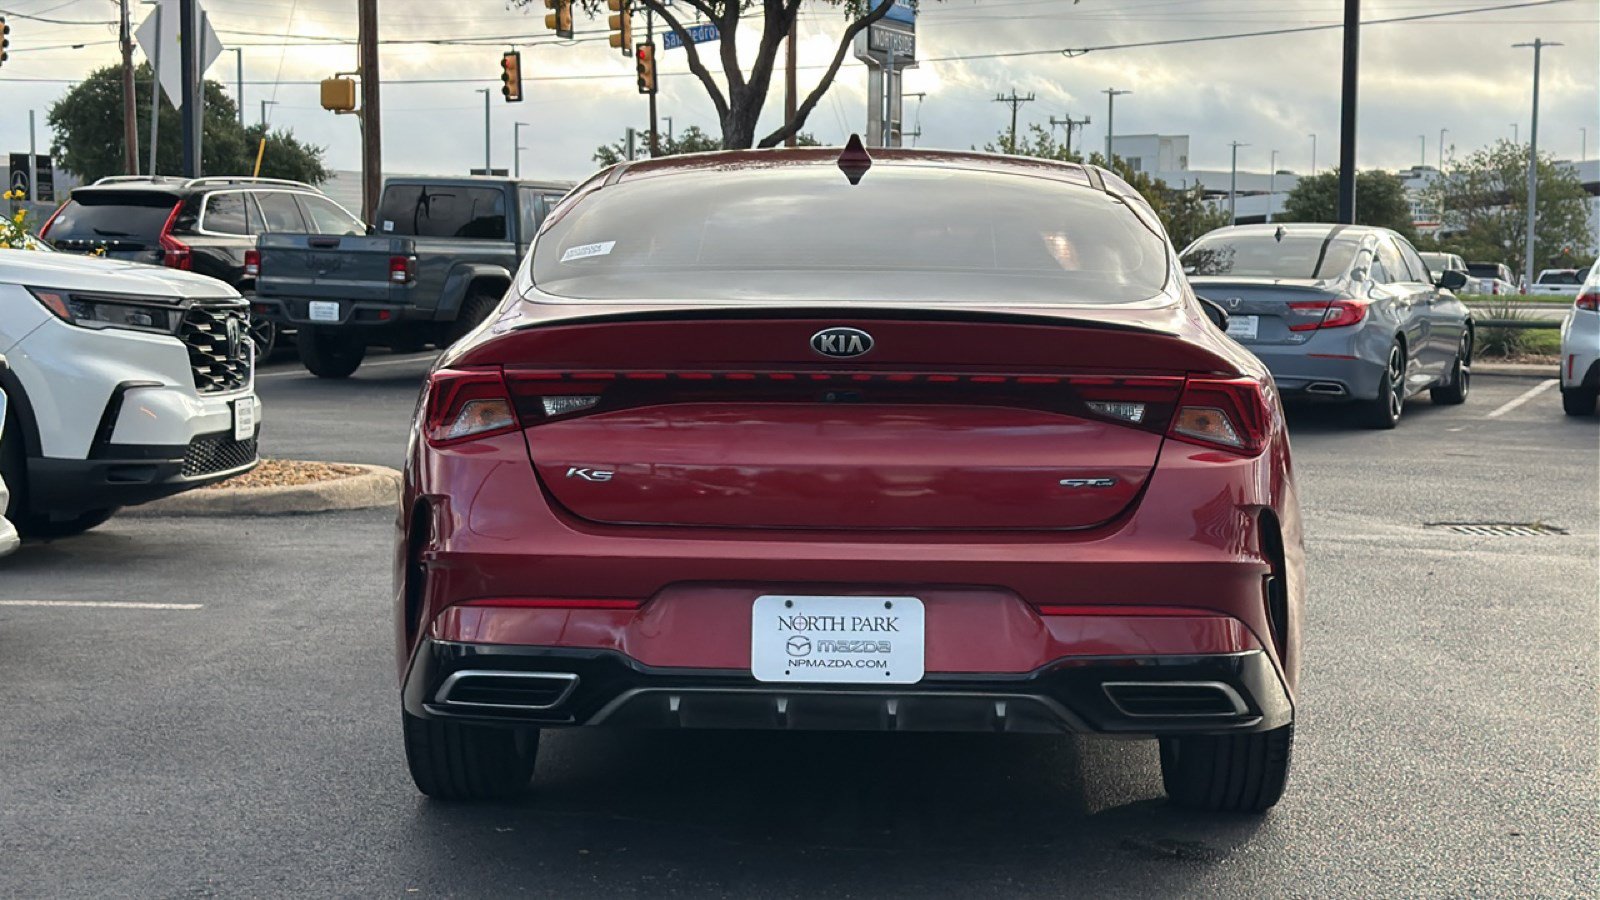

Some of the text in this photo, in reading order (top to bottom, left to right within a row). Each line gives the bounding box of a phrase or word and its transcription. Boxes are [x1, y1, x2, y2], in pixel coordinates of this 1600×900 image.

[875, 30, 912, 51] NORTHSIDE
[821, 335, 864, 352] KIA
[566, 468, 614, 482] K5
[778, 615, 899, 632] NORTH PARK
[817, 639, 892, 653] mazda
[788, 659, 887, 669] NPMAZDA.COM
